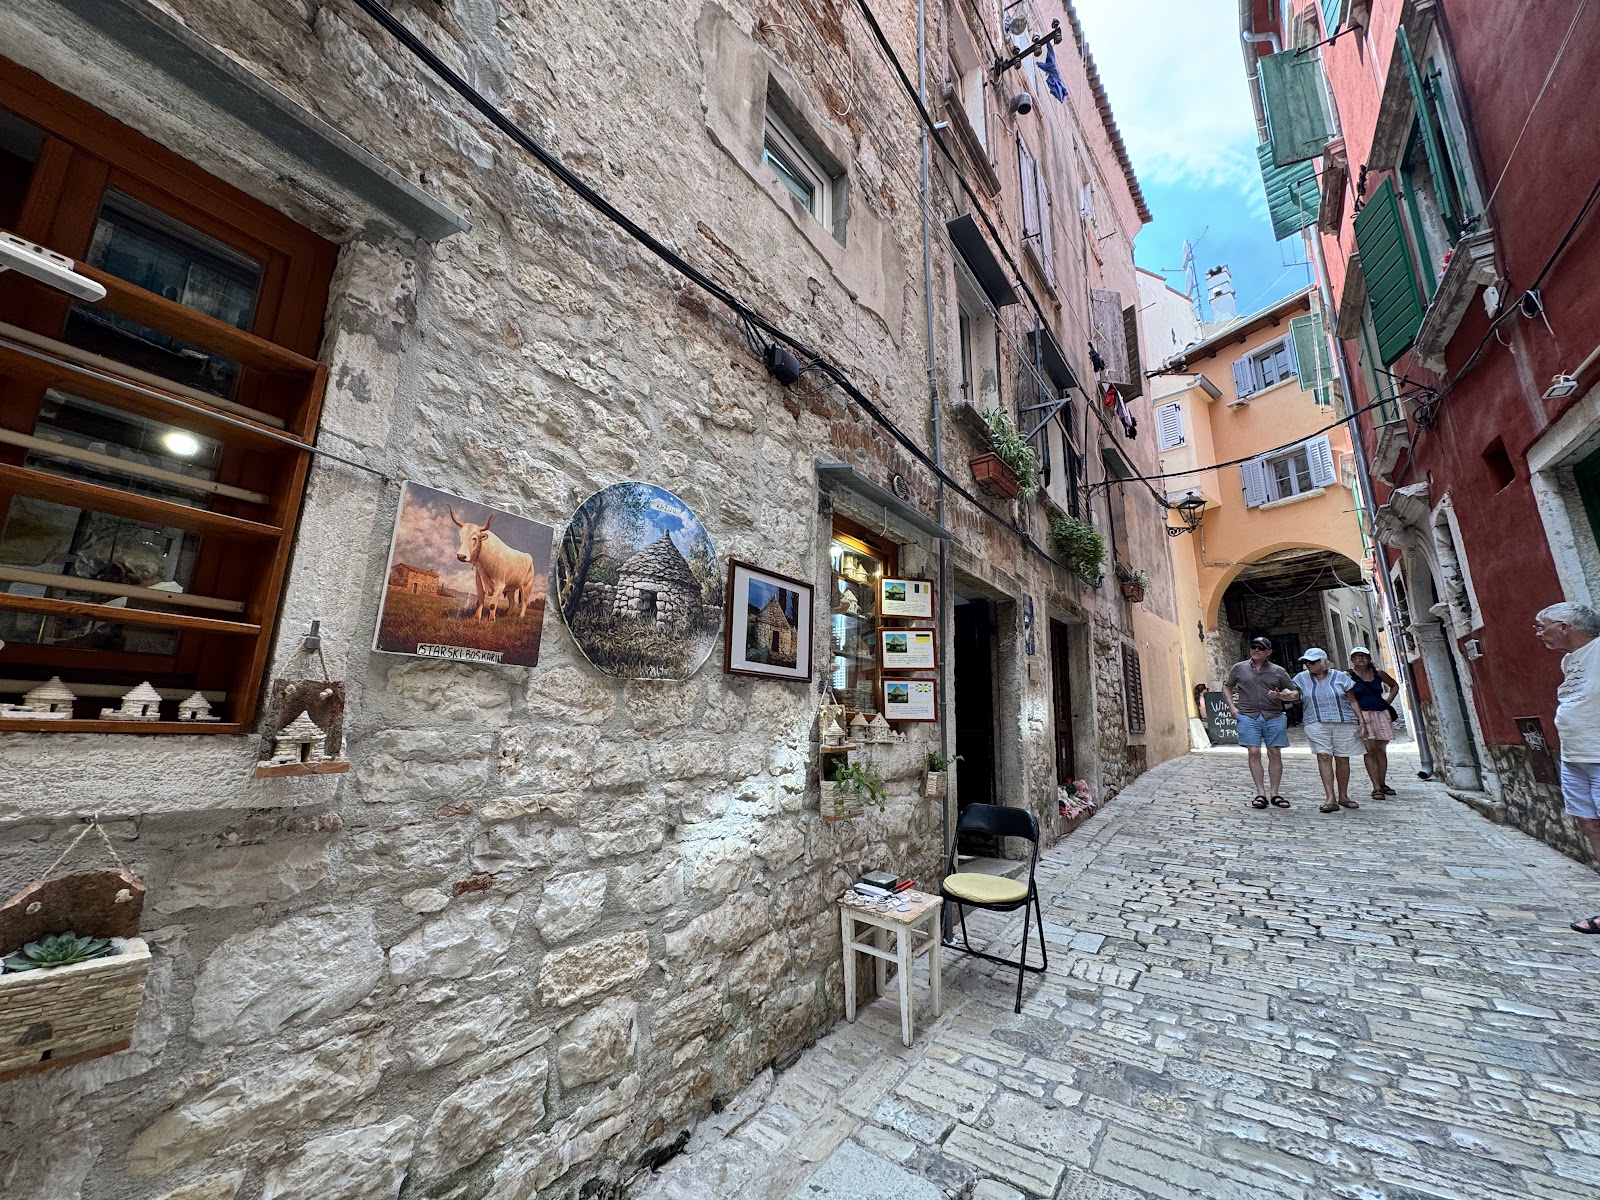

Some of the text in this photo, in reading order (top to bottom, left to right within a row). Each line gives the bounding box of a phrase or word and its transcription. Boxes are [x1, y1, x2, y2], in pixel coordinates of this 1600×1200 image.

[418, 645, 462, 658] ISTARSKI
[1210, 700, 1229, 712] WIN
[1214, 718, 1237, 728] GUITA
